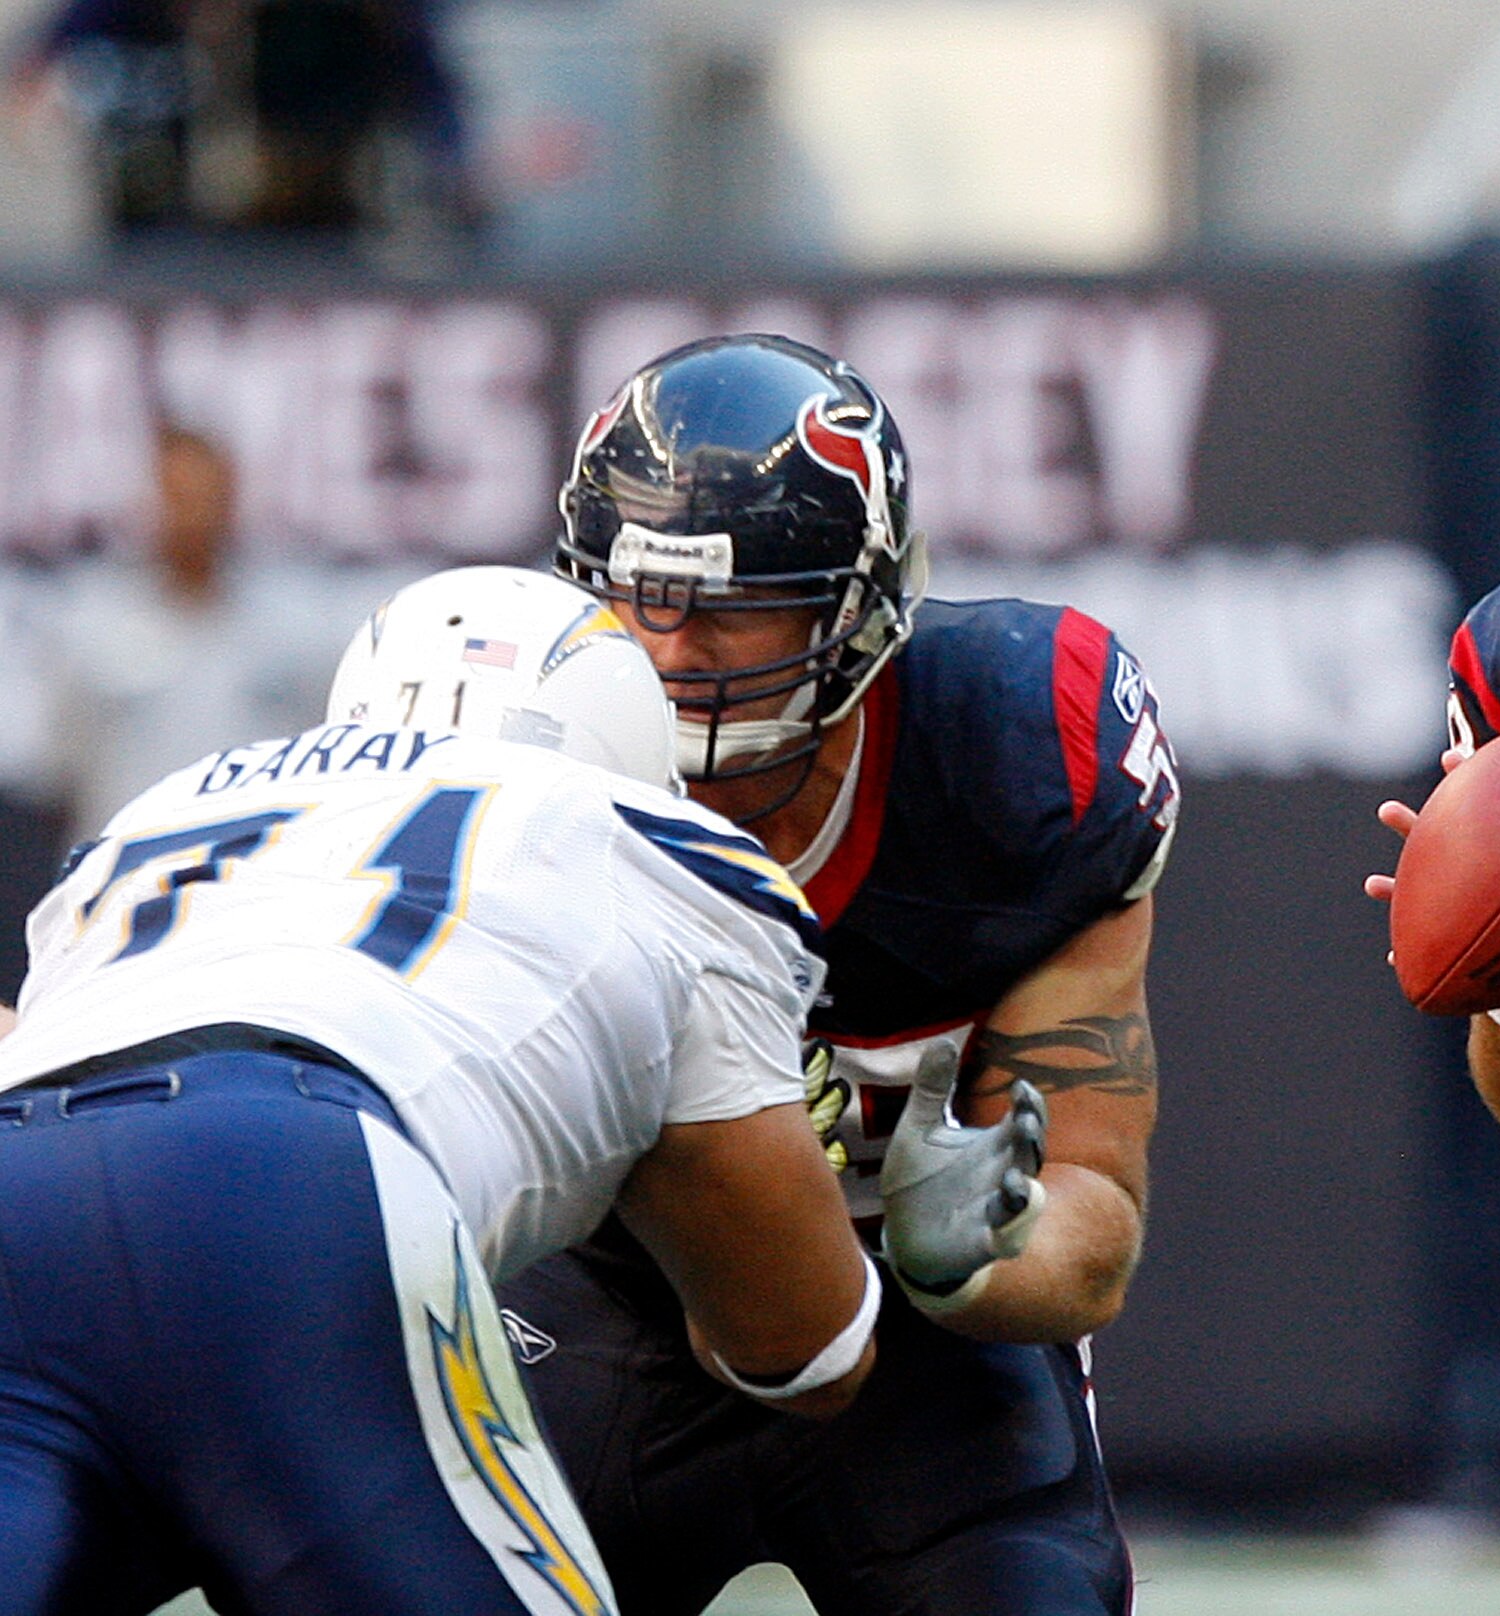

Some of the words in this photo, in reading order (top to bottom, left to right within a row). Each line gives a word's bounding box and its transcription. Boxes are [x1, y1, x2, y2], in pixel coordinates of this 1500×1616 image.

[399, 680, 465, 727] 71
[197, 723, 459, 798] GARAY
[74, 779, 501, 985] 71
